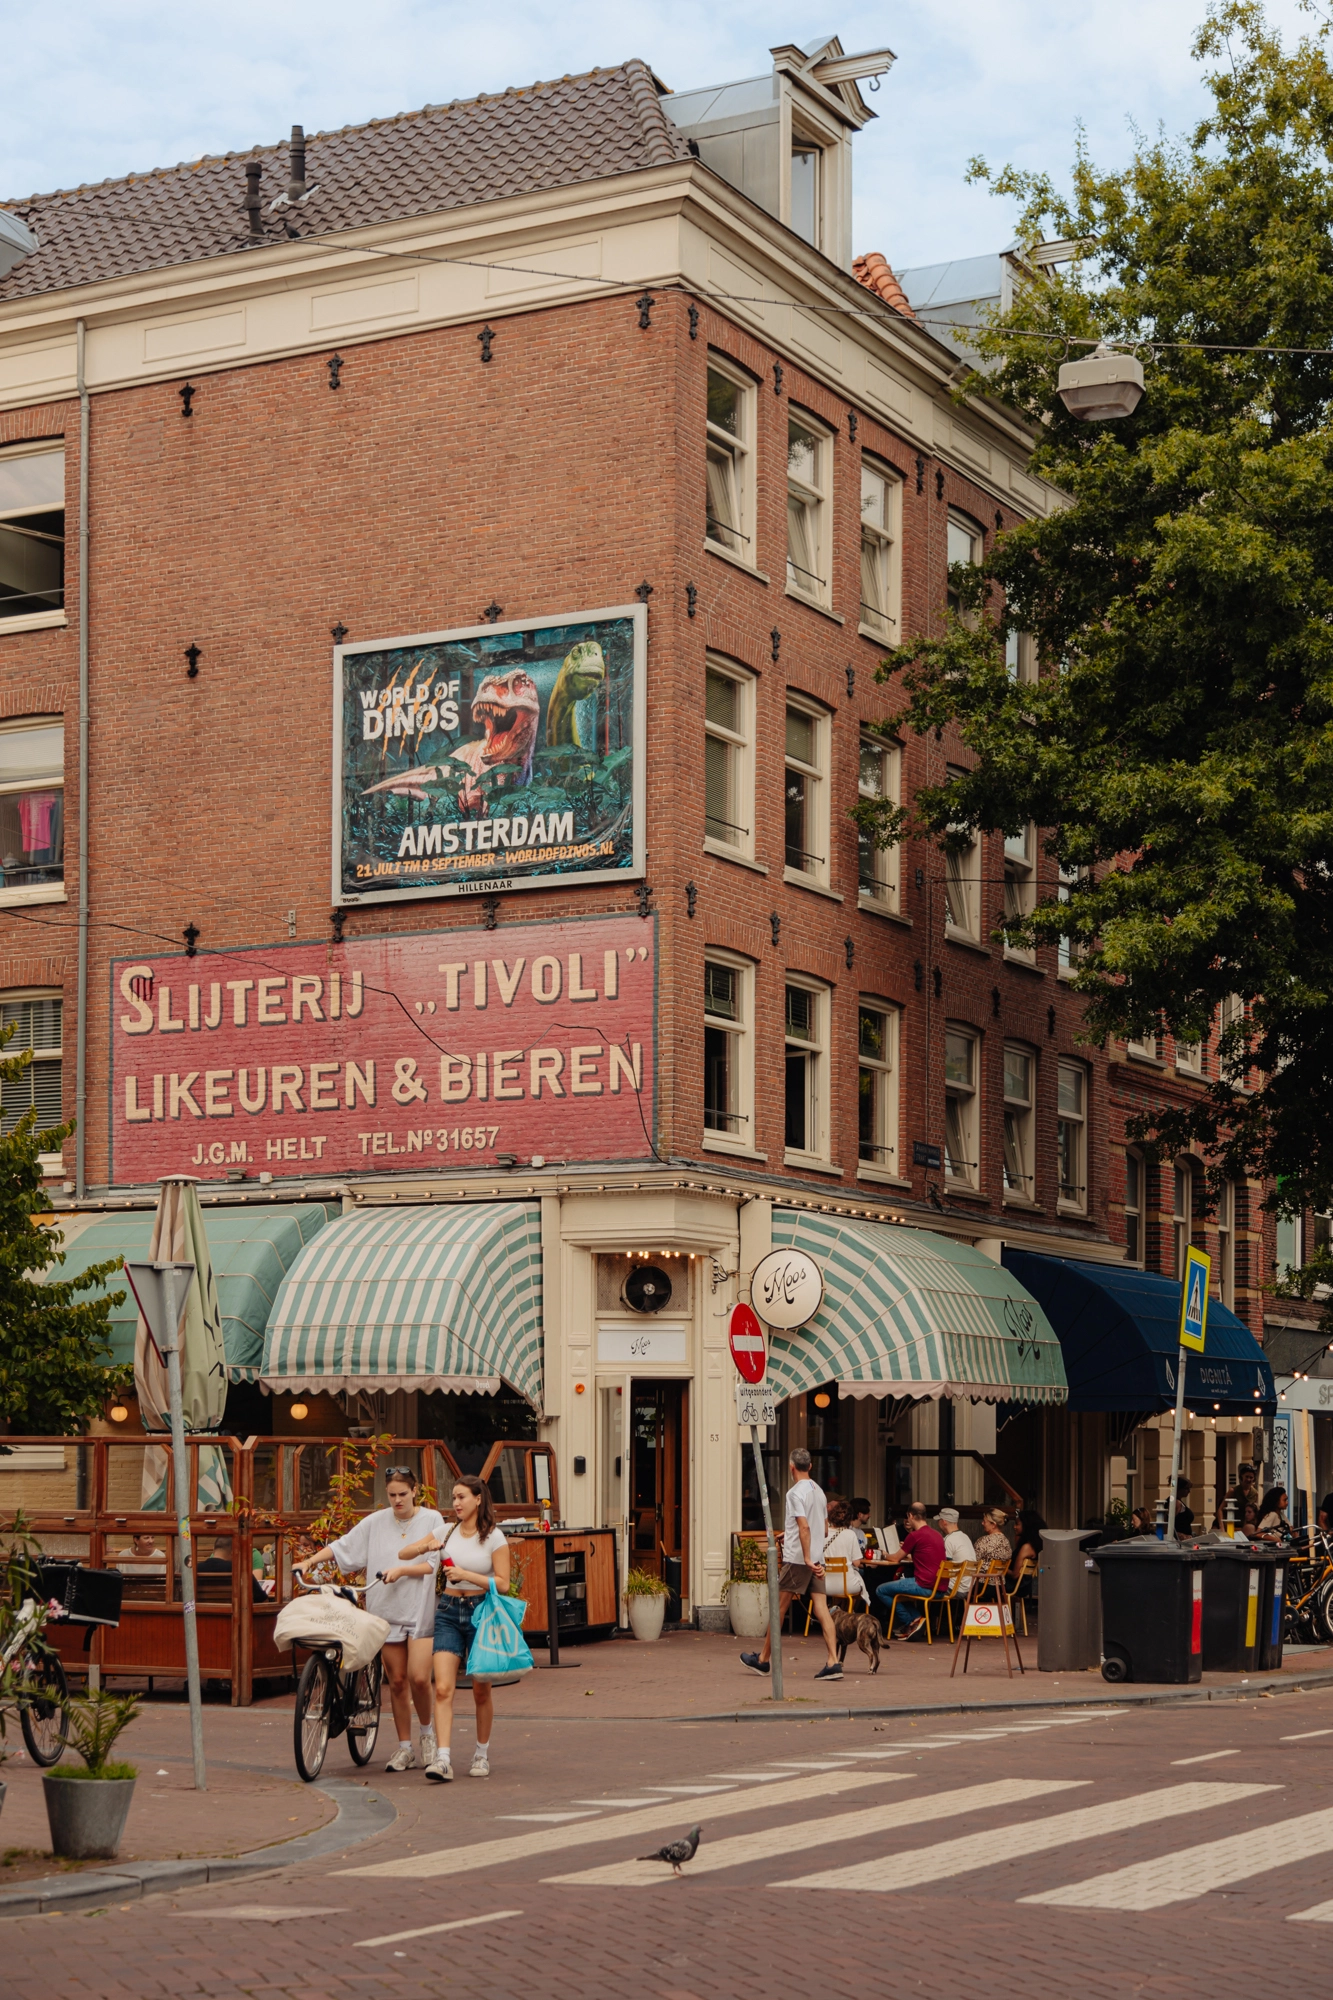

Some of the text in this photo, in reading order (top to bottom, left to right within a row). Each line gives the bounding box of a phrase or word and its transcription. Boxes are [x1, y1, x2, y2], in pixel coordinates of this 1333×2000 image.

[359, 680, 460, 710] WORLD OF
[362, 700, 460, 741] DINOS
[398, 811, 574, 857] AMSTERDAM
[356, 863, 373, 878] 21
[374, 861, 402, 876] JULI
[422, 858, 430, 872] 8
[431, 852, 496, 871] SEPTEMBER
[505, 841, 615, 865] WORLDOFDINOS.NL
[458, 880, 513, 893] HILLENAAR
[119, 965, 365, 1037] SLIJTERIJ
[125, 1042, 644, 1124] LIKEUREN & BIEREN
[191, 1140, 254, 1165] J.G.M.
[266, 1135, 327, 1161] HELT
[436, 1126, 500, 1152] 31657
[763, 1261, 808, 1306] Moos
[630, 1336, 652, 1356] Moos
[1003, 1294, 1041, 1361] Moos
[740, 1388, 773, 1399] uitgezonderd
[710, 1434, 720, 1443] 53
